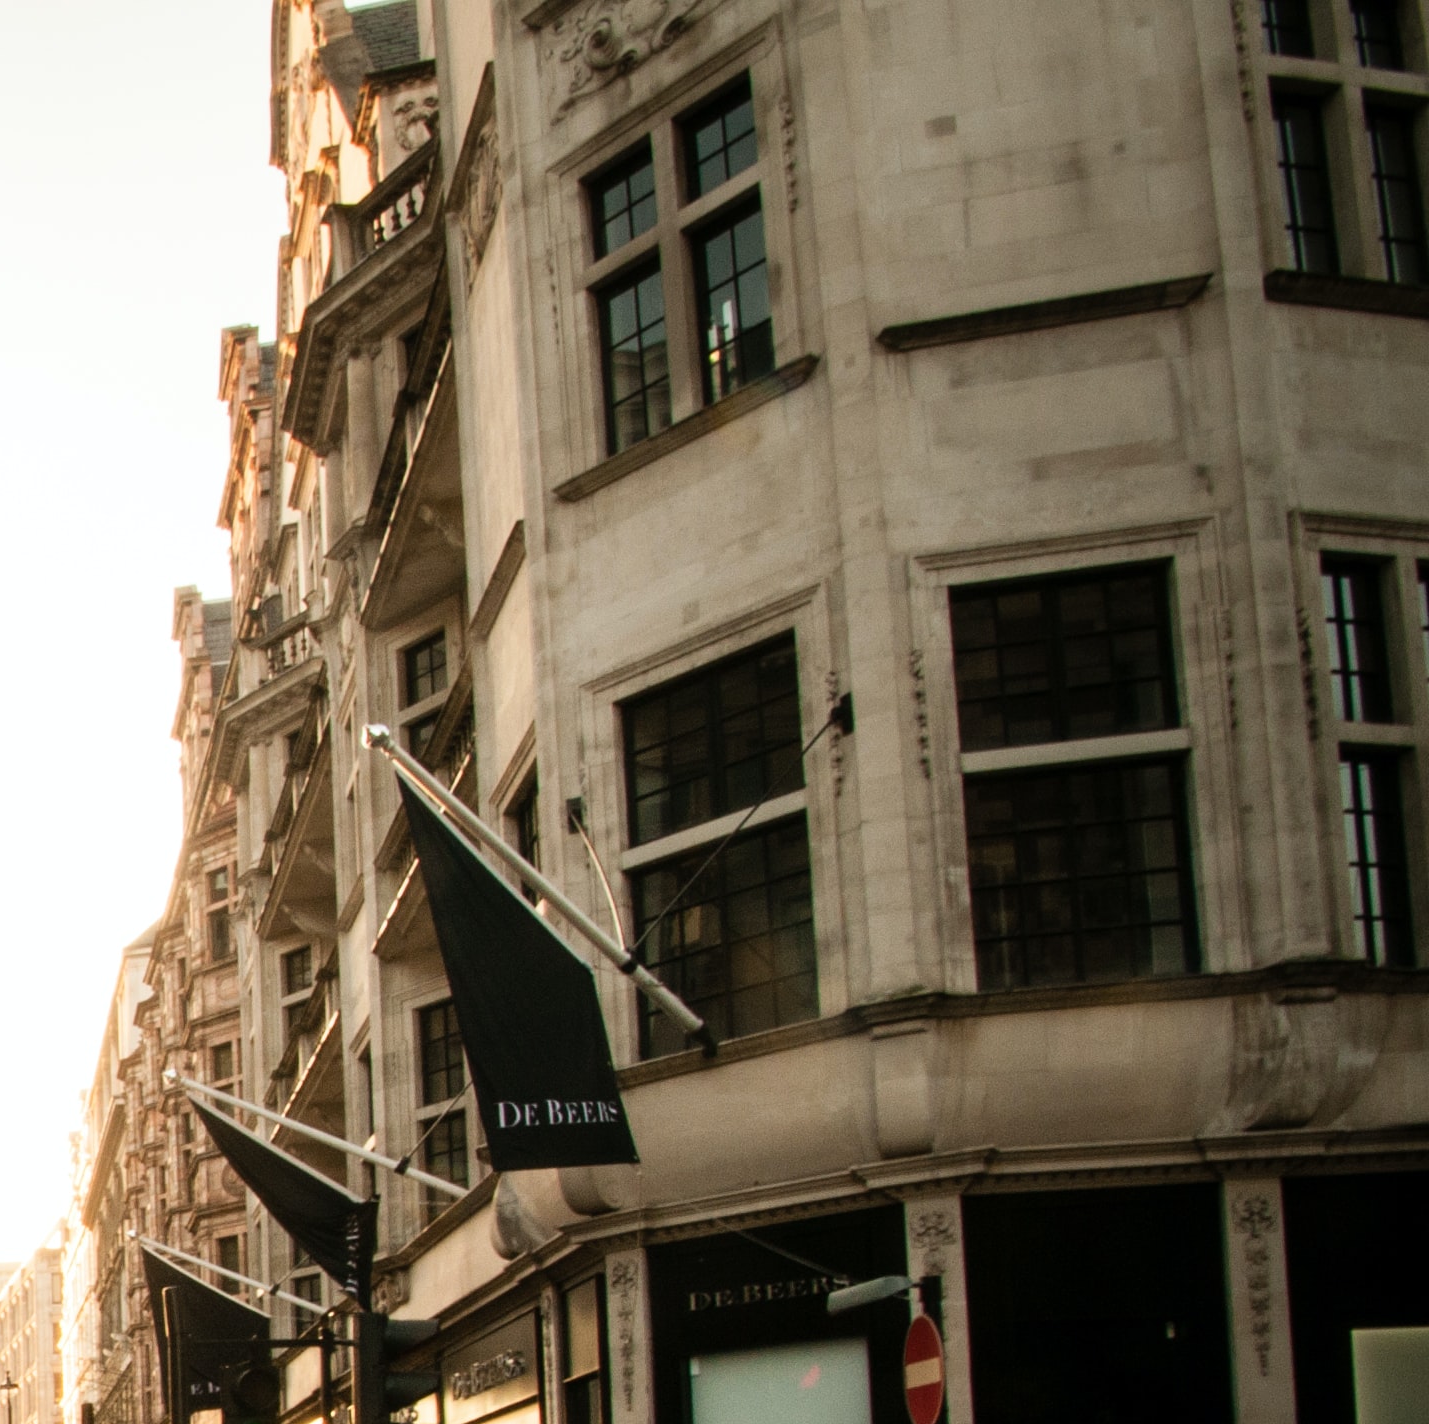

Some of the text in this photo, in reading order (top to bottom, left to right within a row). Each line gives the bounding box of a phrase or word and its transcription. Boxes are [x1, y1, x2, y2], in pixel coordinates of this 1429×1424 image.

[494, 1099, 619, 1128] DE BEERS
[690, 1290, 733, 1311] DE
